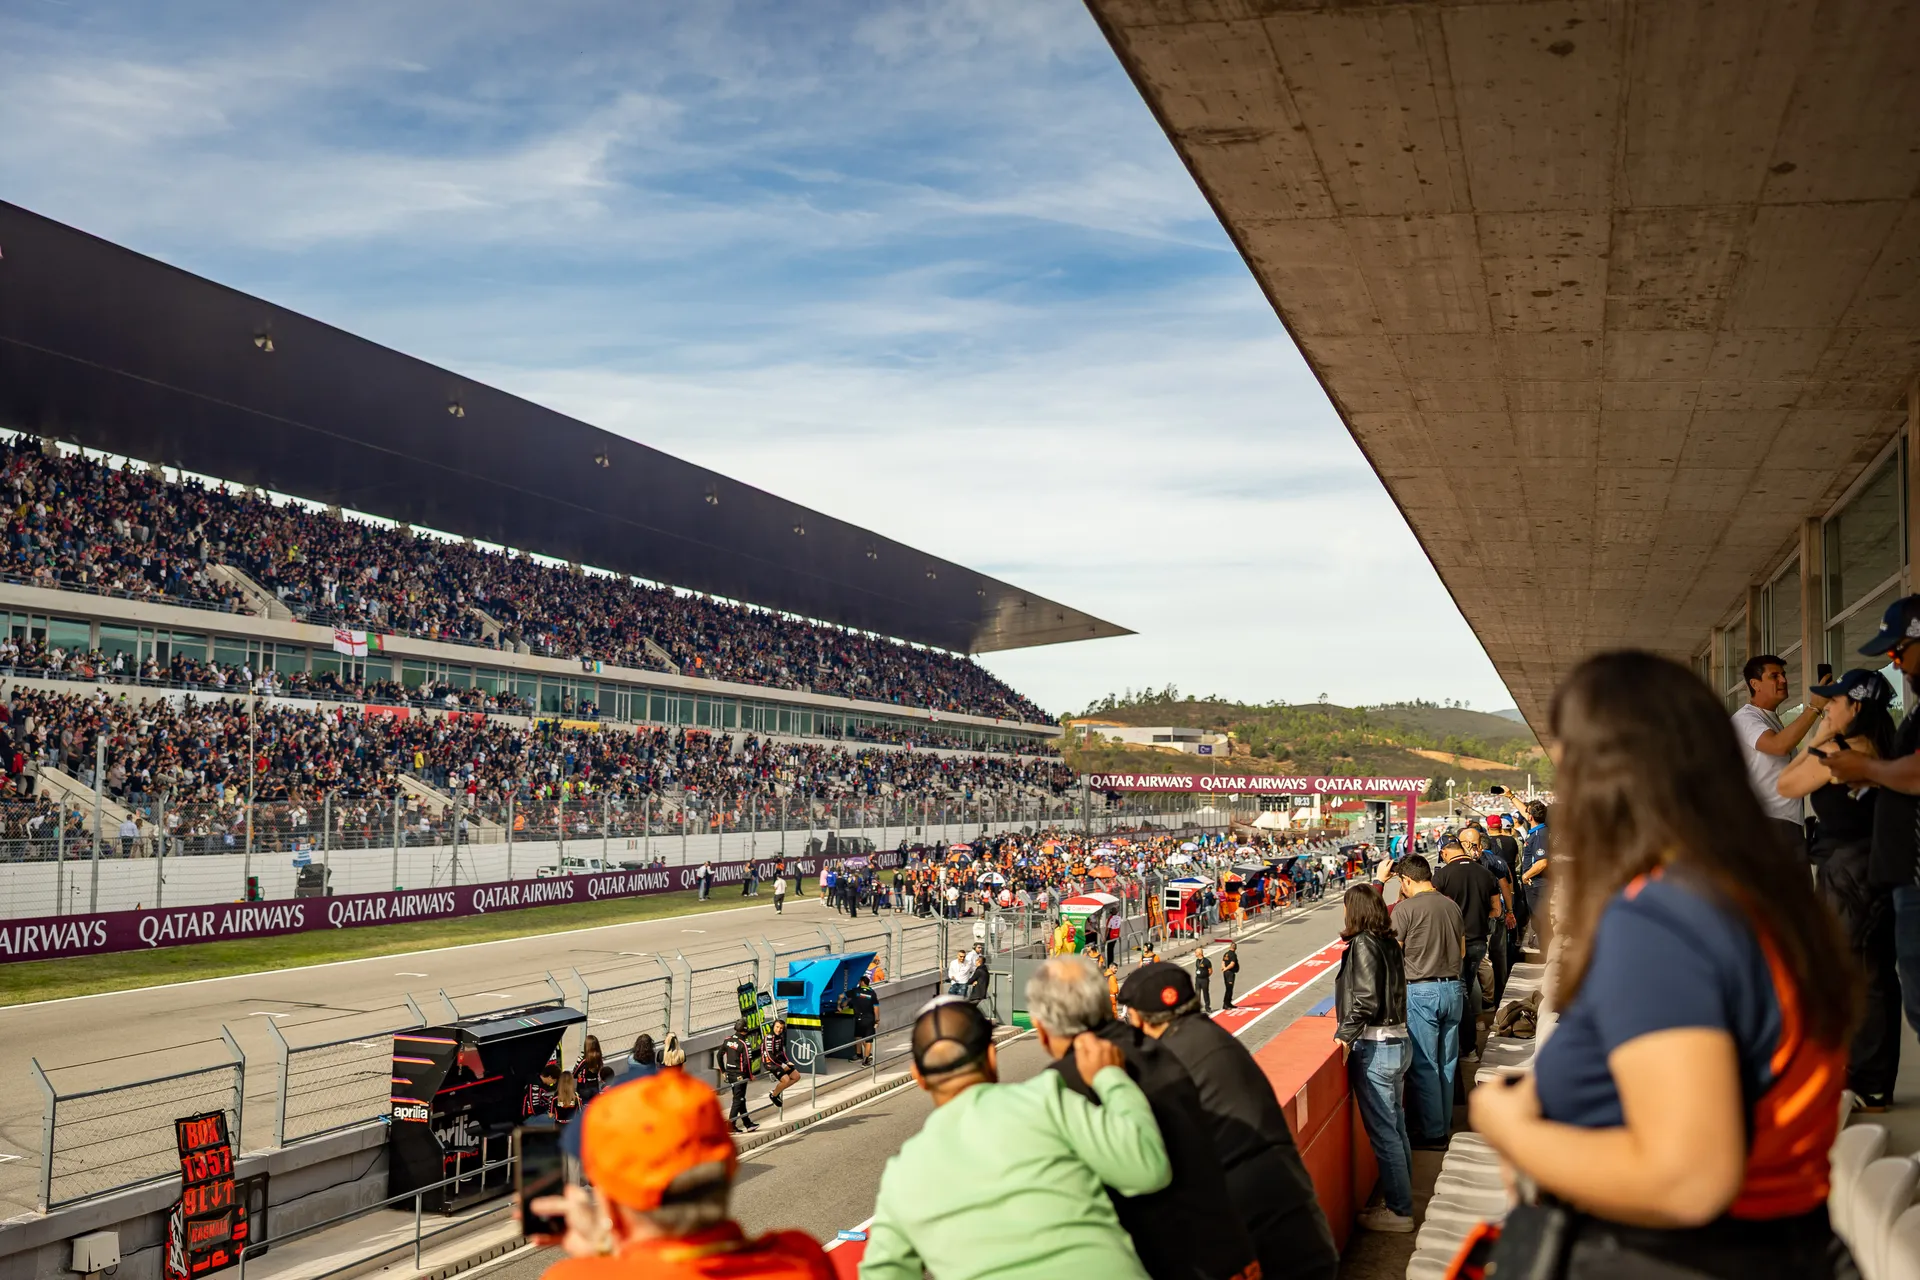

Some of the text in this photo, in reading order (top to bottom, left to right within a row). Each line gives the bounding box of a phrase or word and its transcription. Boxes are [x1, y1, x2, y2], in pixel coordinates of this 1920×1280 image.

[1090, 774, 1193, 789] QATAR AIRWAYS
[1200, 776, 1307, 791] QATAR AIRWAYS
[1315, 778, 1425, 792] QATAR AIRWAYS
[713, 864, 746, 882] AIRWAY
[878, 853, 897, 870] QATAR
[473, 880, 574, 913] QATAR AIRWAYS
[588, 875, 625, 900] QATAR
[626, 871, 670, 892] AIRWAYS
[139, 904, 304, 947] QATAR AIRWAYS
[328, 892, 455, 929] QATAR AIRWAYS
[0, 919, 107, 955] AIRWAYS
[394, 1105, 428, 1119] aprilia
[186, 1117, 219, 1149] BOX
[435, 1114, 480, 1147] prilia
[183, 1145, 231, 1183] 1357
